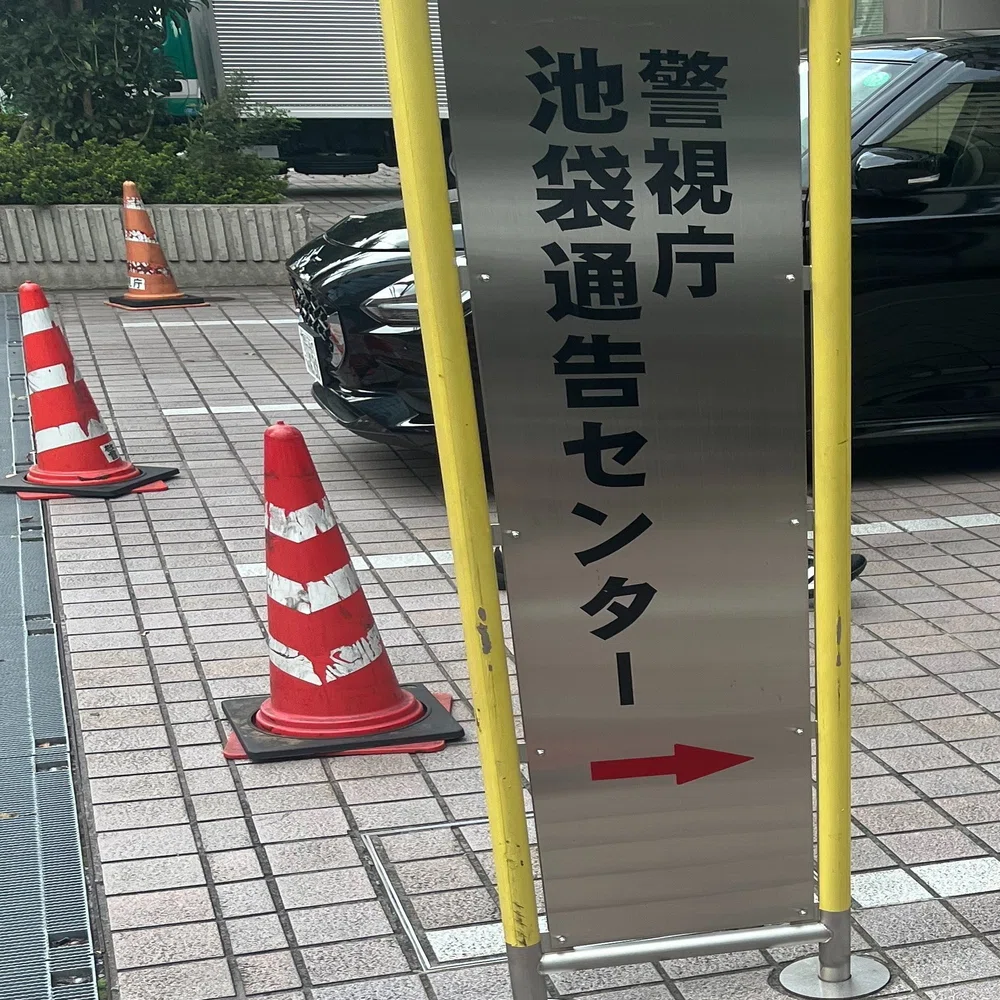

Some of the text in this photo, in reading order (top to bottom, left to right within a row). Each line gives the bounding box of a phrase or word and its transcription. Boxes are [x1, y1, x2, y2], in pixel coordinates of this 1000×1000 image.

[524, 45, 658, 706] 池袋通告センター
[638, 48, 736, 299] 警視庁
